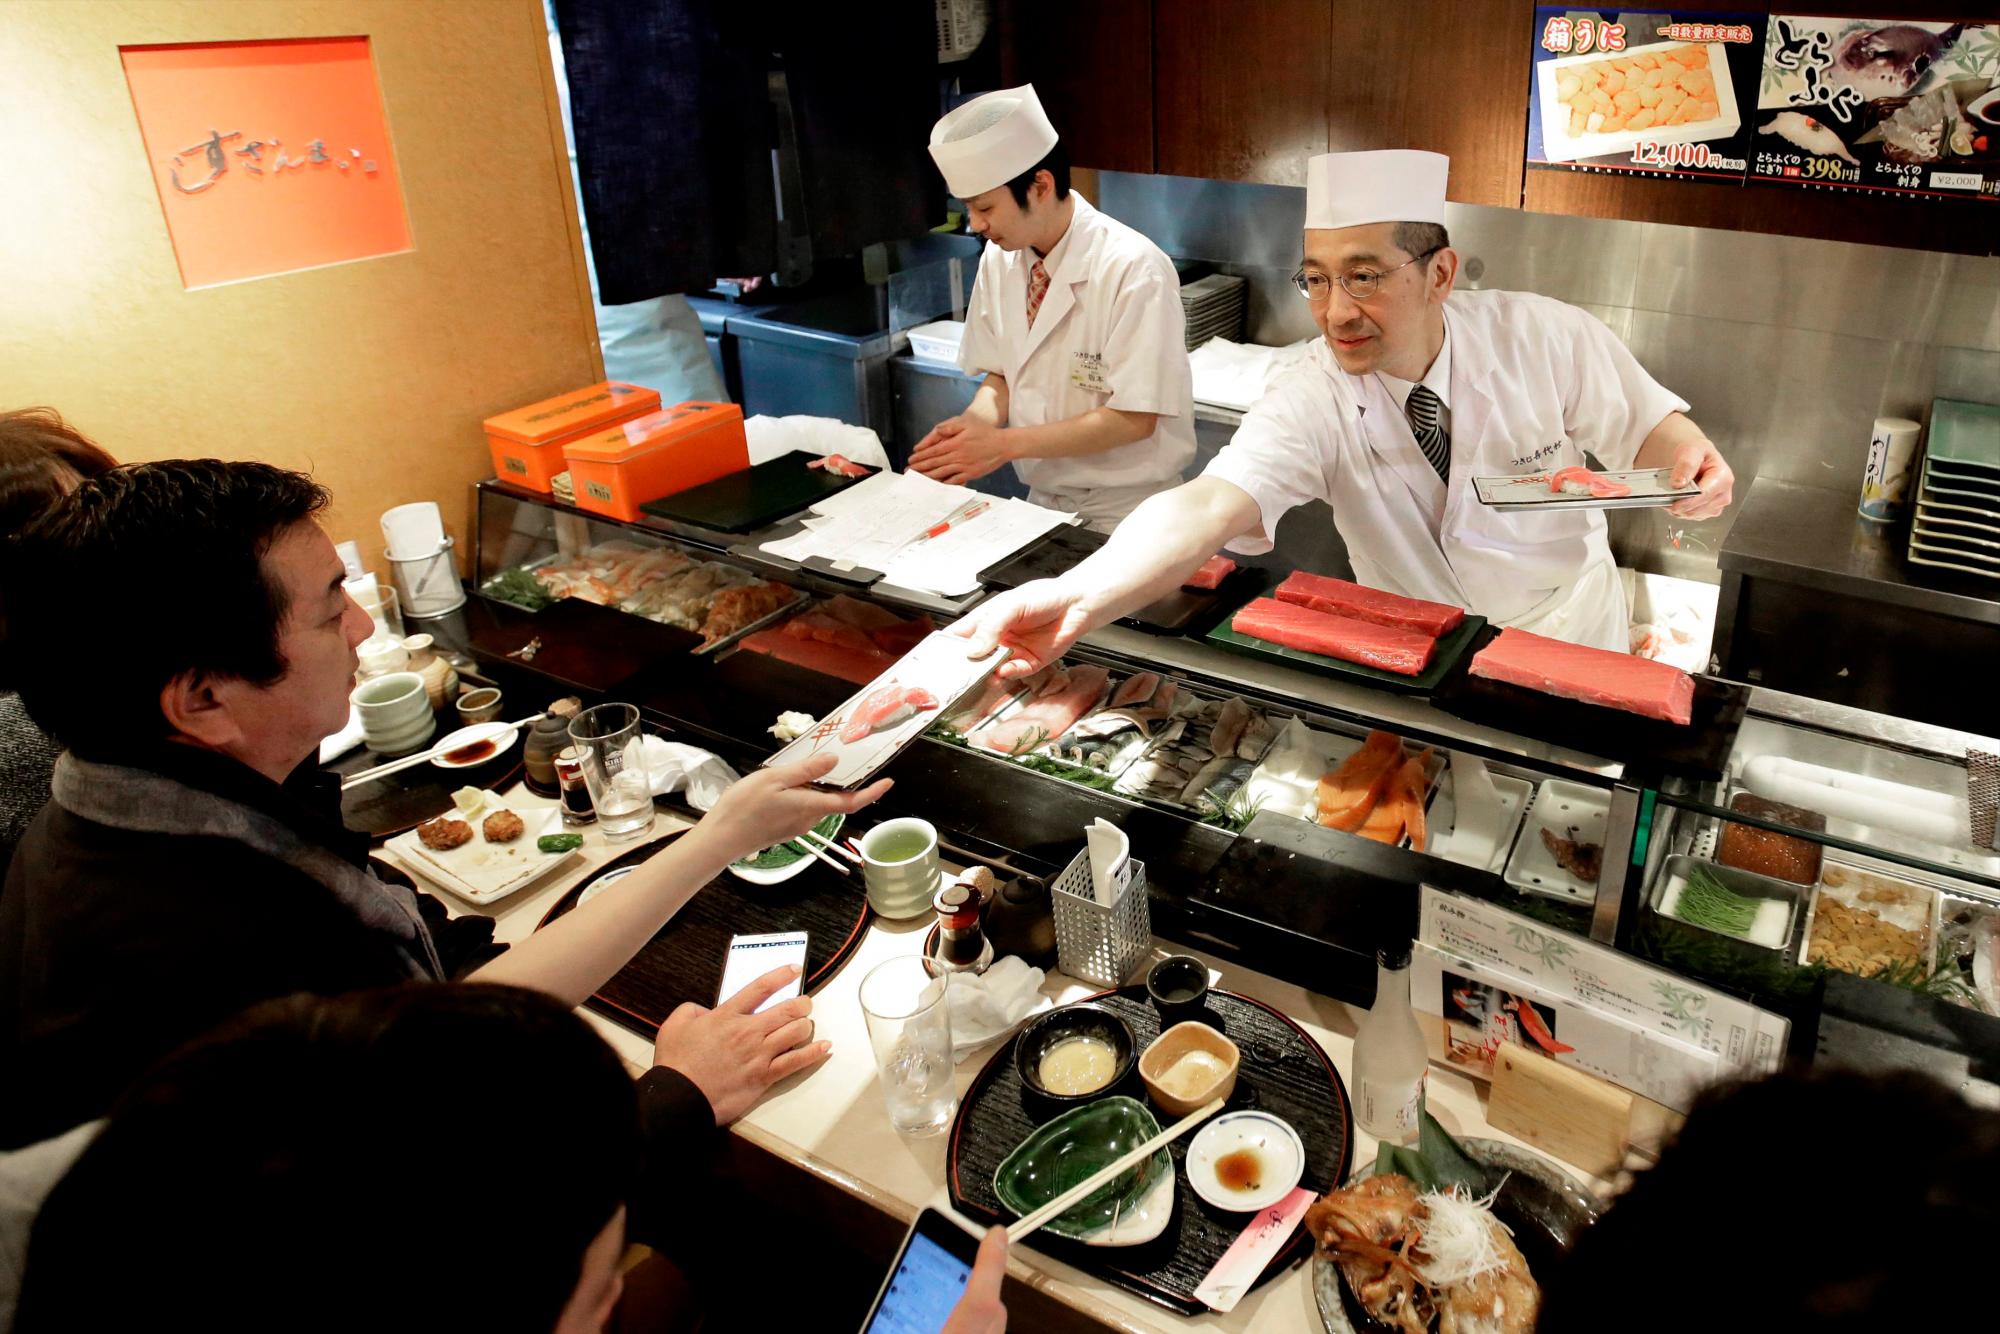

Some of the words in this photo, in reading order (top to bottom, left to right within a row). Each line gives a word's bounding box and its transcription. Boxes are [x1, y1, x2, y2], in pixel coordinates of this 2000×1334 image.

[1542, 17, 1626, 53] 箱うに
[1657, 24, 1753, 43] 一日数量限定販売
[1756, 152, 1801, 165] とらふぐの
[1755, 163, 1783, 176] にぎり
[1875, 162, 1922, 175] とらふぐの
[1896, 175, 1921, 189] 刺身
